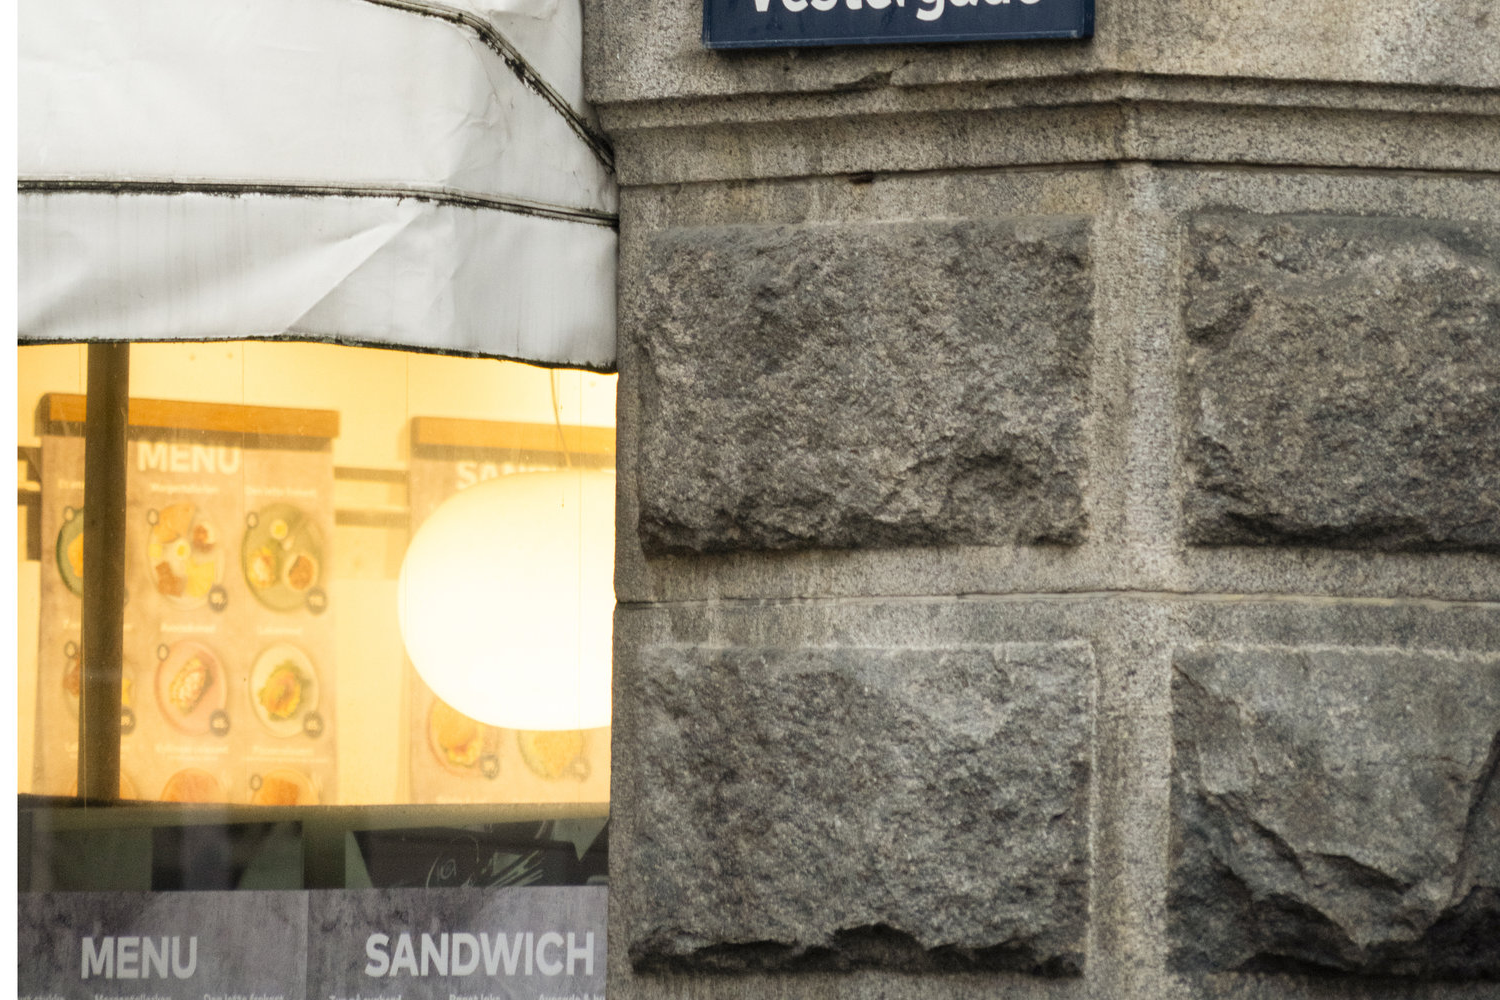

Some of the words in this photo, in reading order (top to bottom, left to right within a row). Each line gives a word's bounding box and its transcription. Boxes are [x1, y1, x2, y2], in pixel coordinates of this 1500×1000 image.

[136, 441, 241, 475] MENU
[80, 936, 198, 979] MENU
[364, 932, 595, 977] SANDWICH
